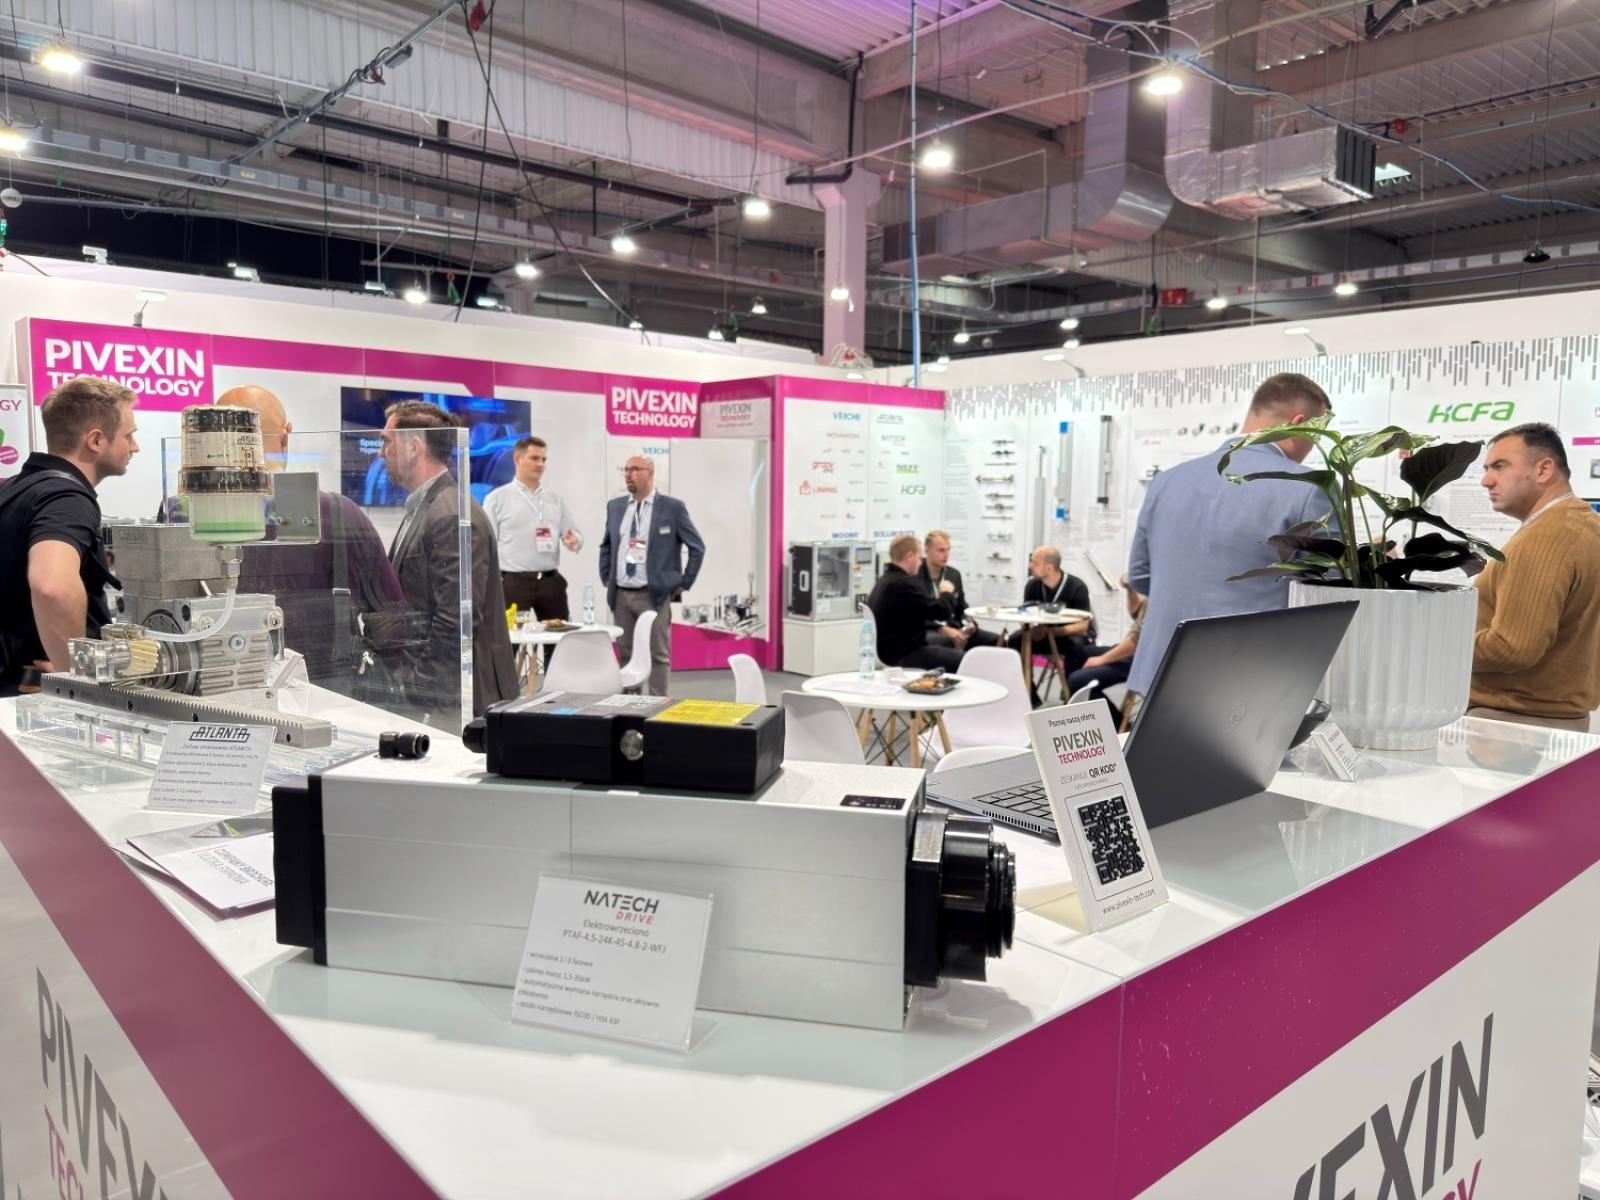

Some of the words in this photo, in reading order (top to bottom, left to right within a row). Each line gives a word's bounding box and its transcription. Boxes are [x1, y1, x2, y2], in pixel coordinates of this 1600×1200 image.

[45, 338, 205, 378] PIVEXIN
[47, 371, 204, 397] TENOLOGY
[612, 386, 698, 414] PIVEXIN
[612, 410, 697, 429] TECHNOLOGY
[189, 726, 251, 742] ATLANTA
[1052, 727, 1104, 754] PIVEXIN
[1057, 745, 1106, 765] TECHNOLOGY
[1088, 767, 1101, 779] QR
[583, 889, 660, 914] NATECH
[615, 911, 655, 925] DRIVE
